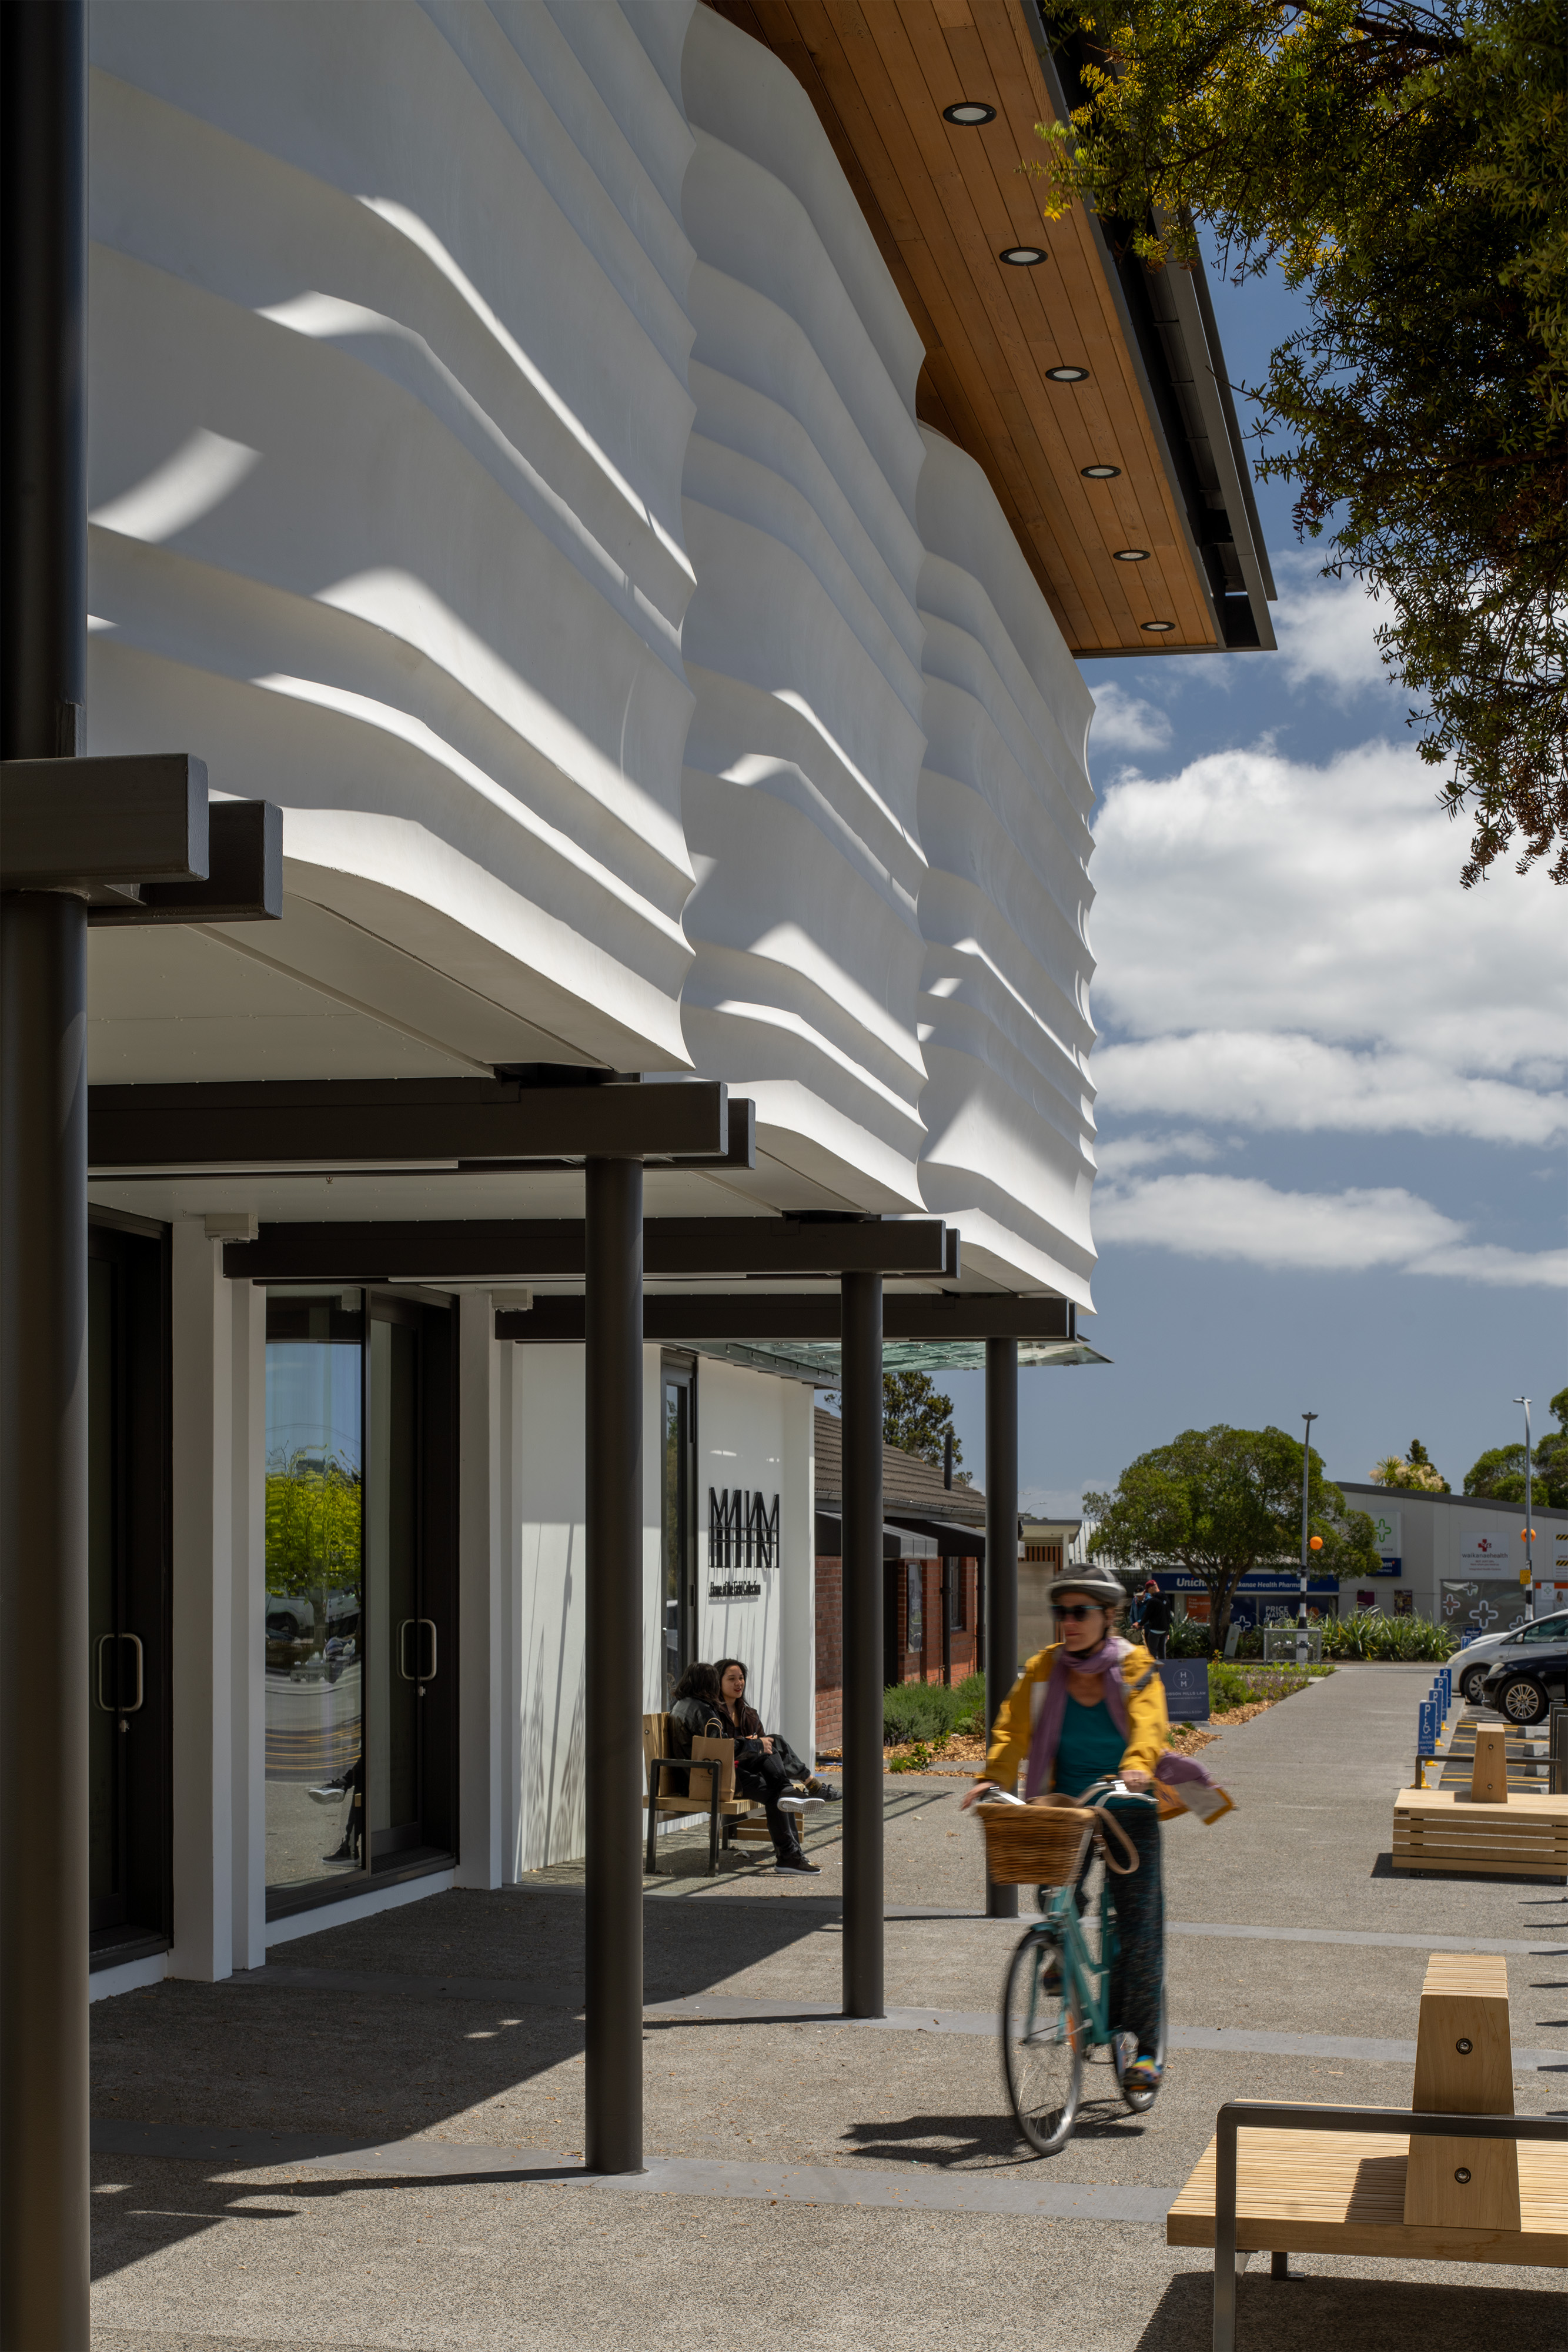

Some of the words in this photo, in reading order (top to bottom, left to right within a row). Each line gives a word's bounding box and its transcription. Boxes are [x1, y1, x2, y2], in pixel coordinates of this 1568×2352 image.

[1438, 1679, 1443, 1689] P
[1433, 1692, 1438, 1700] P
[1425, 1705, 1430, 1716] P
